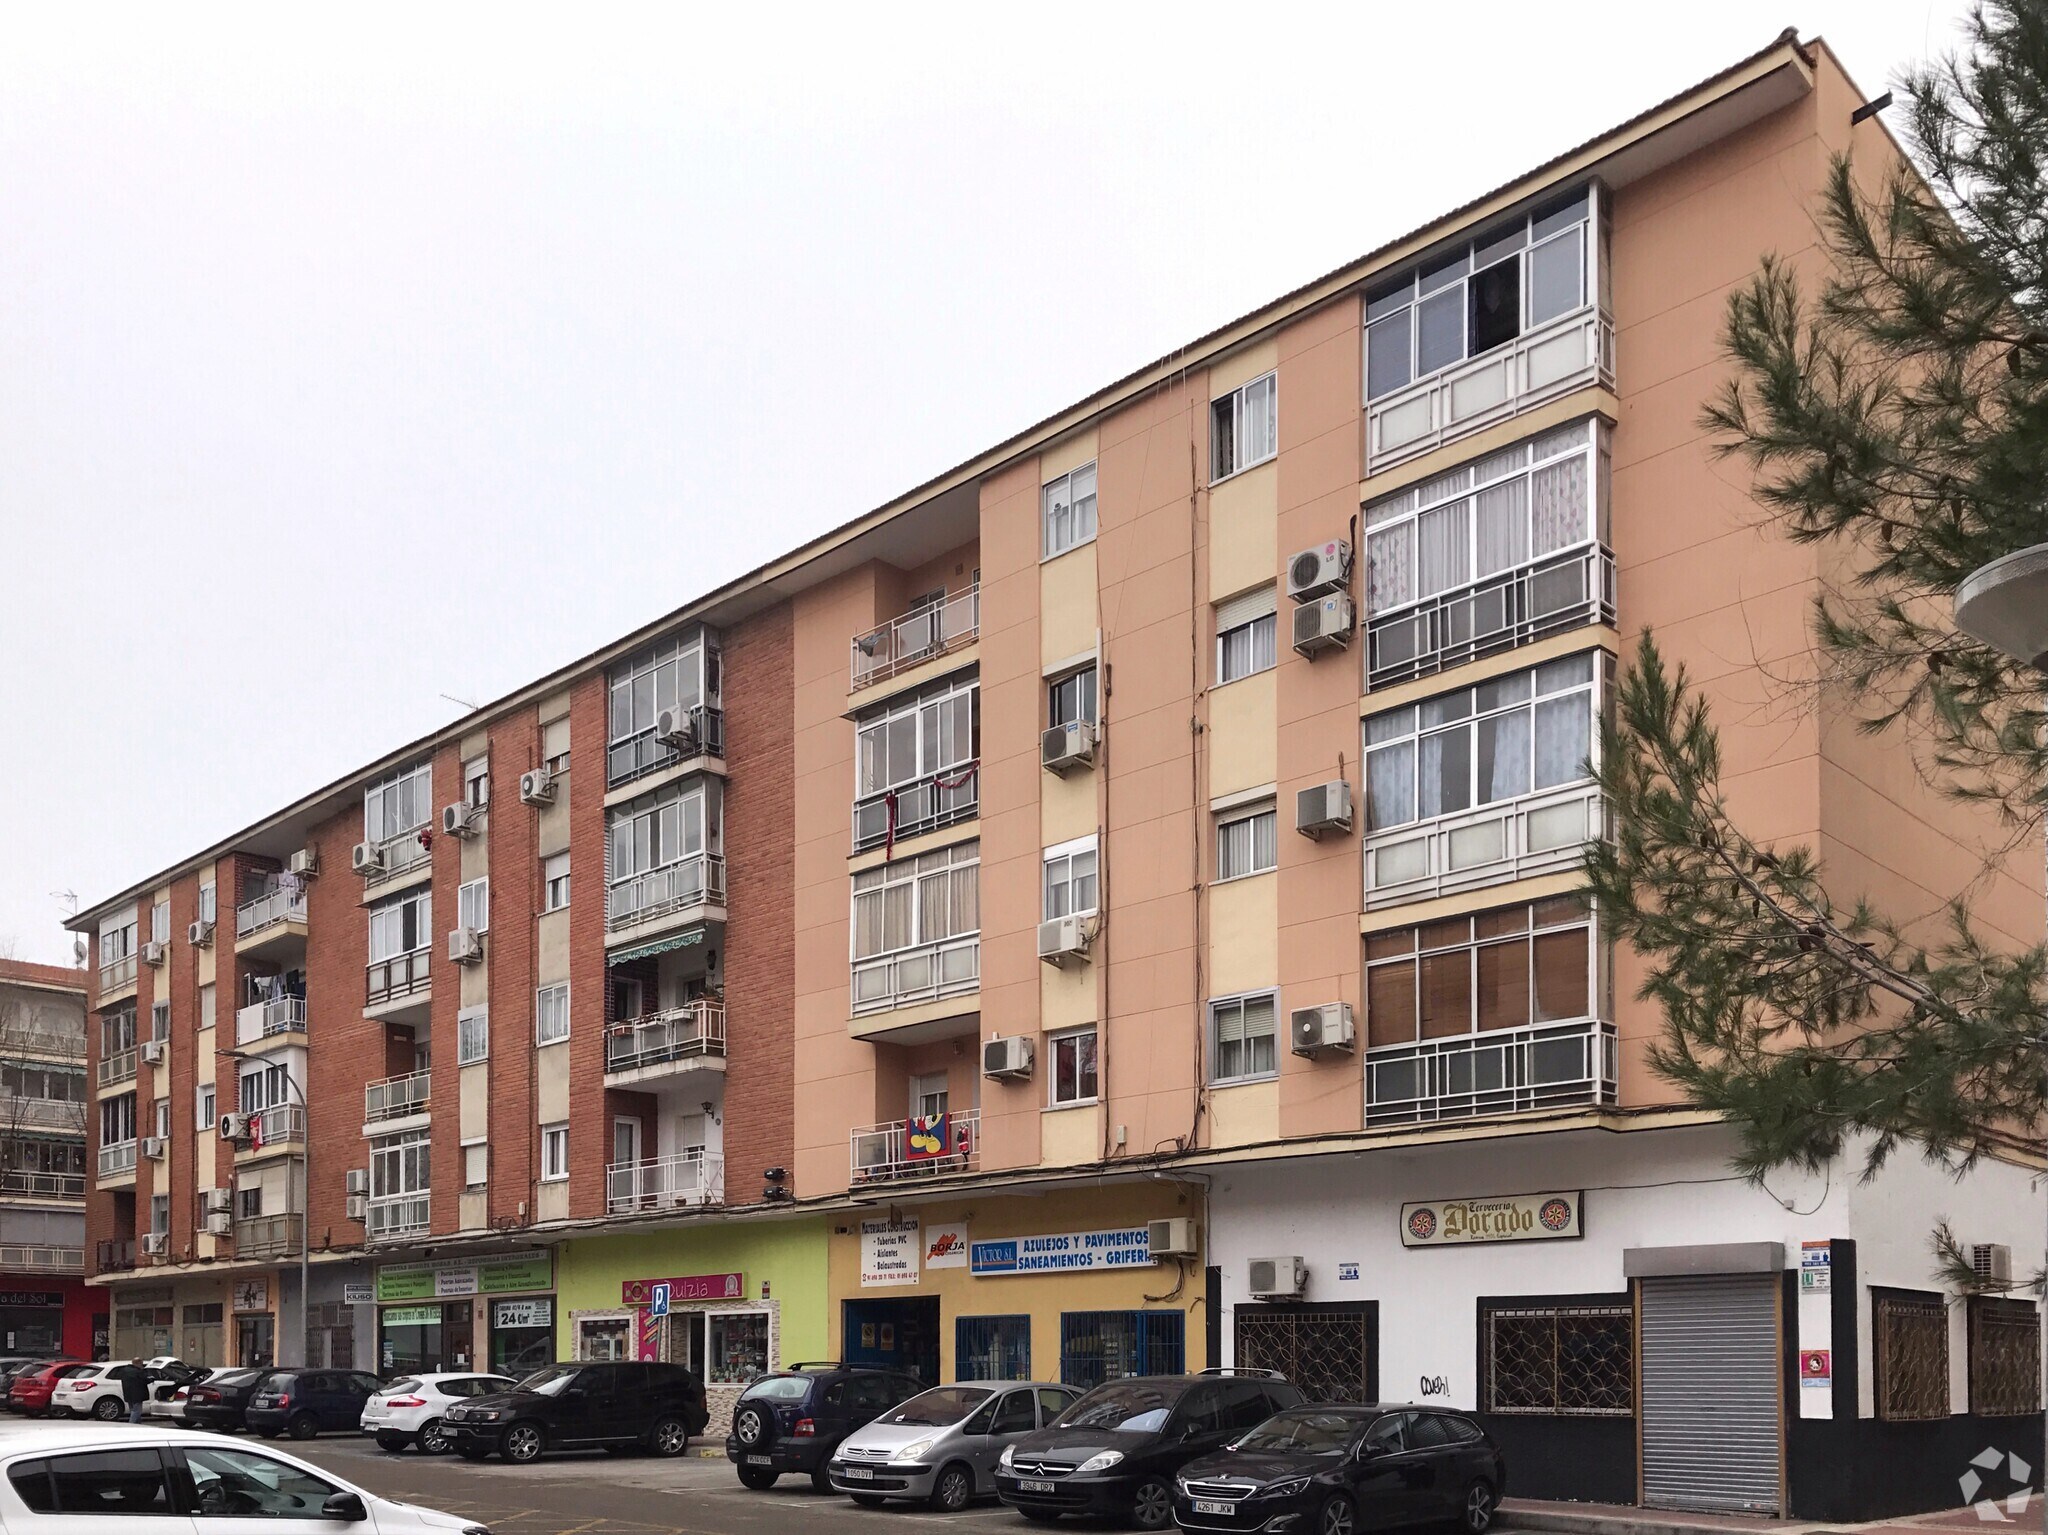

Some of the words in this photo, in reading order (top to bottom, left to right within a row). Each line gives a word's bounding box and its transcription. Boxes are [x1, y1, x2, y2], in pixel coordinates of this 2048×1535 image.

[1443, 1202, 1533, 1238] Dorado
[897, 1235, 907, 1244] PVC
[1024, 1235, 1069, 1252] AZULEJOS
[1073, 1236, 1080, 1249] Y
[1085, 1230, 1149, 1248] PAVIMENTOS
[930, 1242, 965, 1252] BORJA
[877, 1248, 898, 1258] Aislantes
[1018, 1252, 1093, 1270] SANEAMIENTOS
[1106, 1249, 1151, 1265] GRIFERI
[656, 1288, 663, 1312] P
[501, 1313, 516, 1325] 24
[1021, 1481, 1038, 1490] 3946
[1040, 1483, 1054, 1492] DRZ
[1198, 1502, 1214, 1512] 4261
